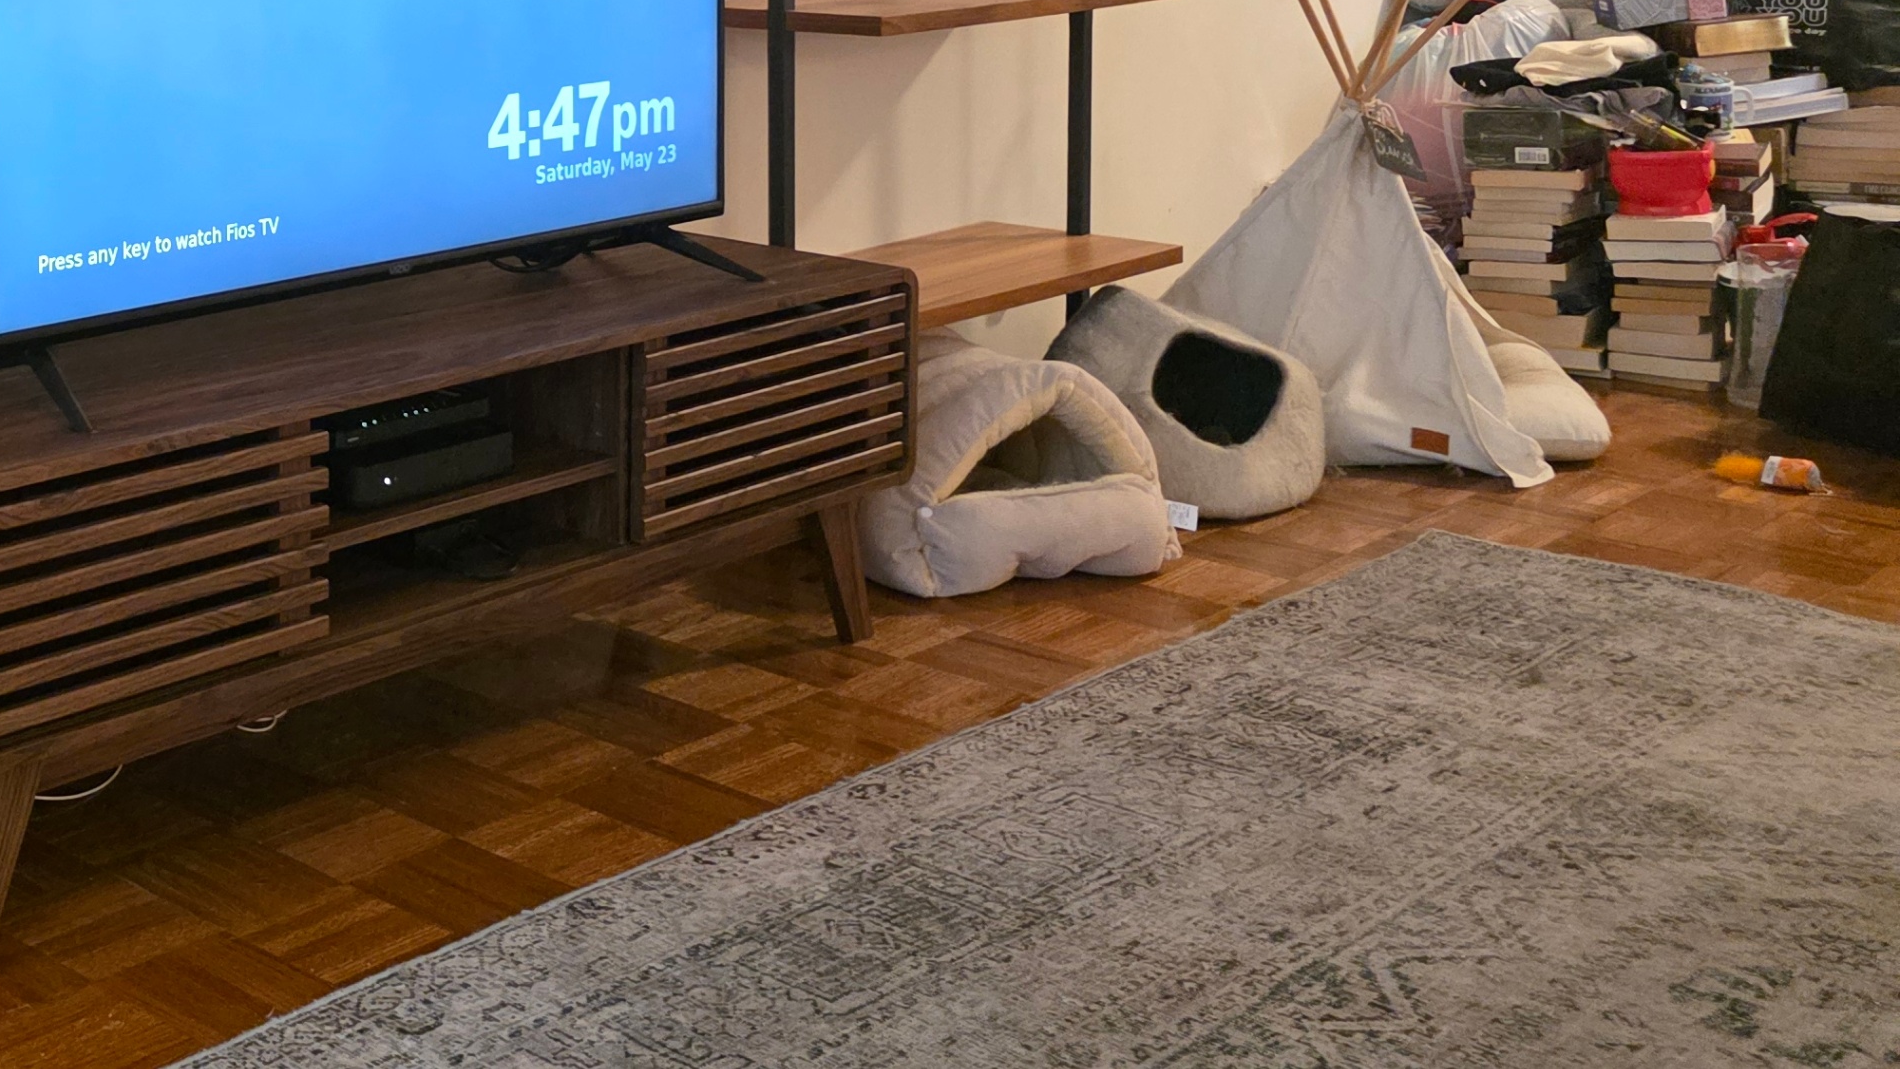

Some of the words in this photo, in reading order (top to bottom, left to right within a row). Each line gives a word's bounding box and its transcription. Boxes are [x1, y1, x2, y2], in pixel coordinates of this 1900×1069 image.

[487, 80, 675, 160] 4:47pm
[535, 156, 615, 184] Saturday,
[620, 150, 653, 172] May
[657, 143, 677, 165] 23
[37, 253, 84, 274] Press
[88, 246, 118, 266] any
[122, 240, 151, 260] key
[154, 236, 172, 254] to
[175, 226, 222, 251] watch
[226, 222, 256, 242] Fios
[258, 216, 280, 236] TV
